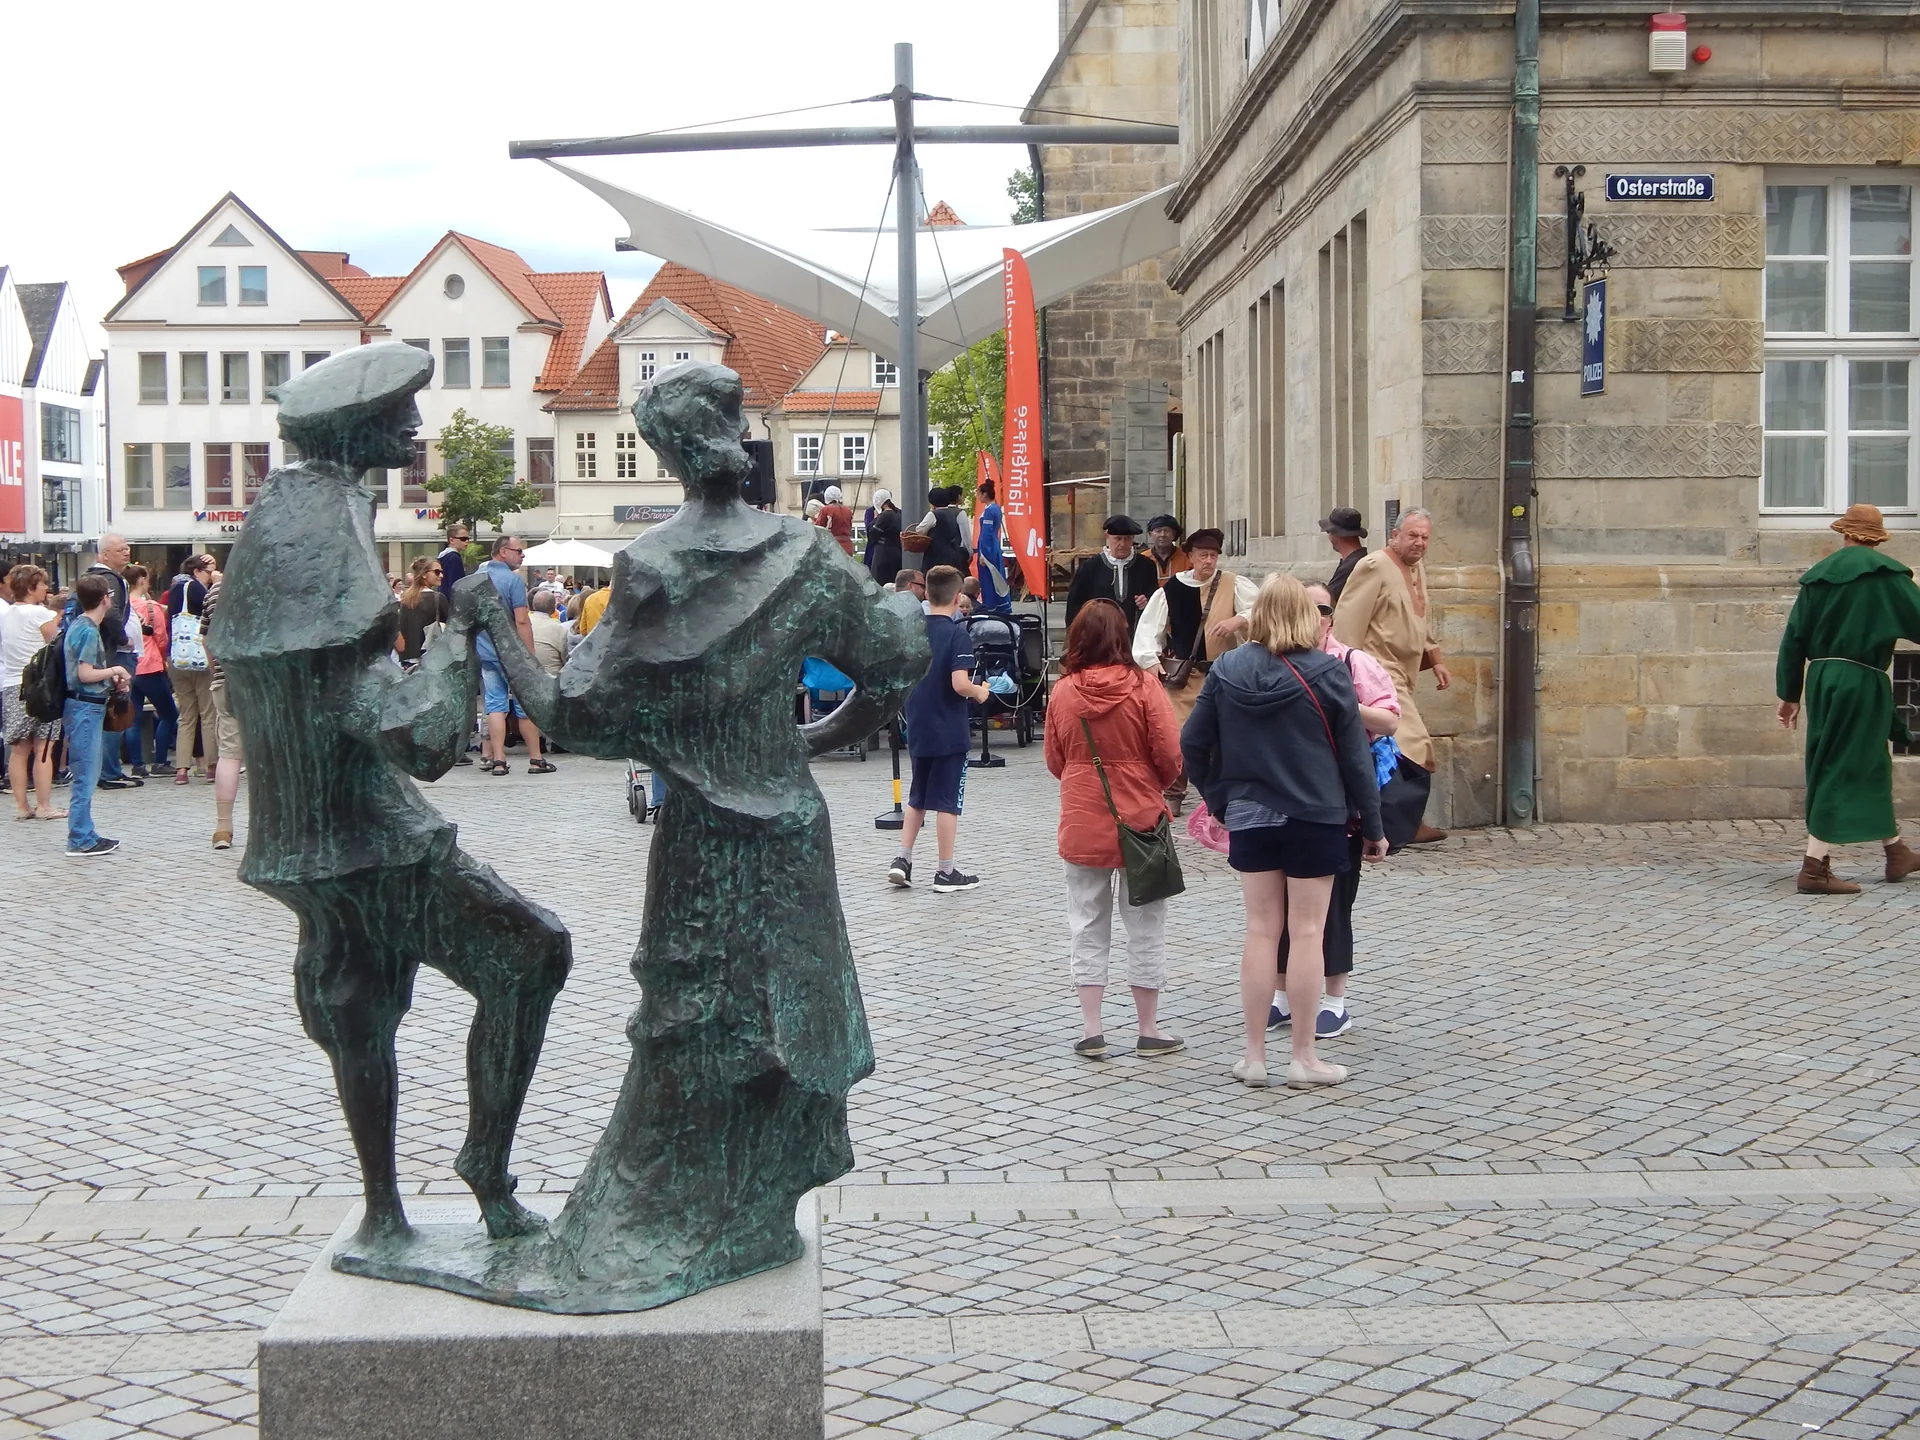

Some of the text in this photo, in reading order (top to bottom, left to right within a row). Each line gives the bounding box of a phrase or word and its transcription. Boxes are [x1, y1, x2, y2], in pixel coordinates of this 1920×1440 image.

[1616, 178, 1705, 196] Osterstraße
[1583, 362, 1603, 382] POLIZEI
[0, 440, 22, 487] ALE
[403, 469, 426, 478] Schö
